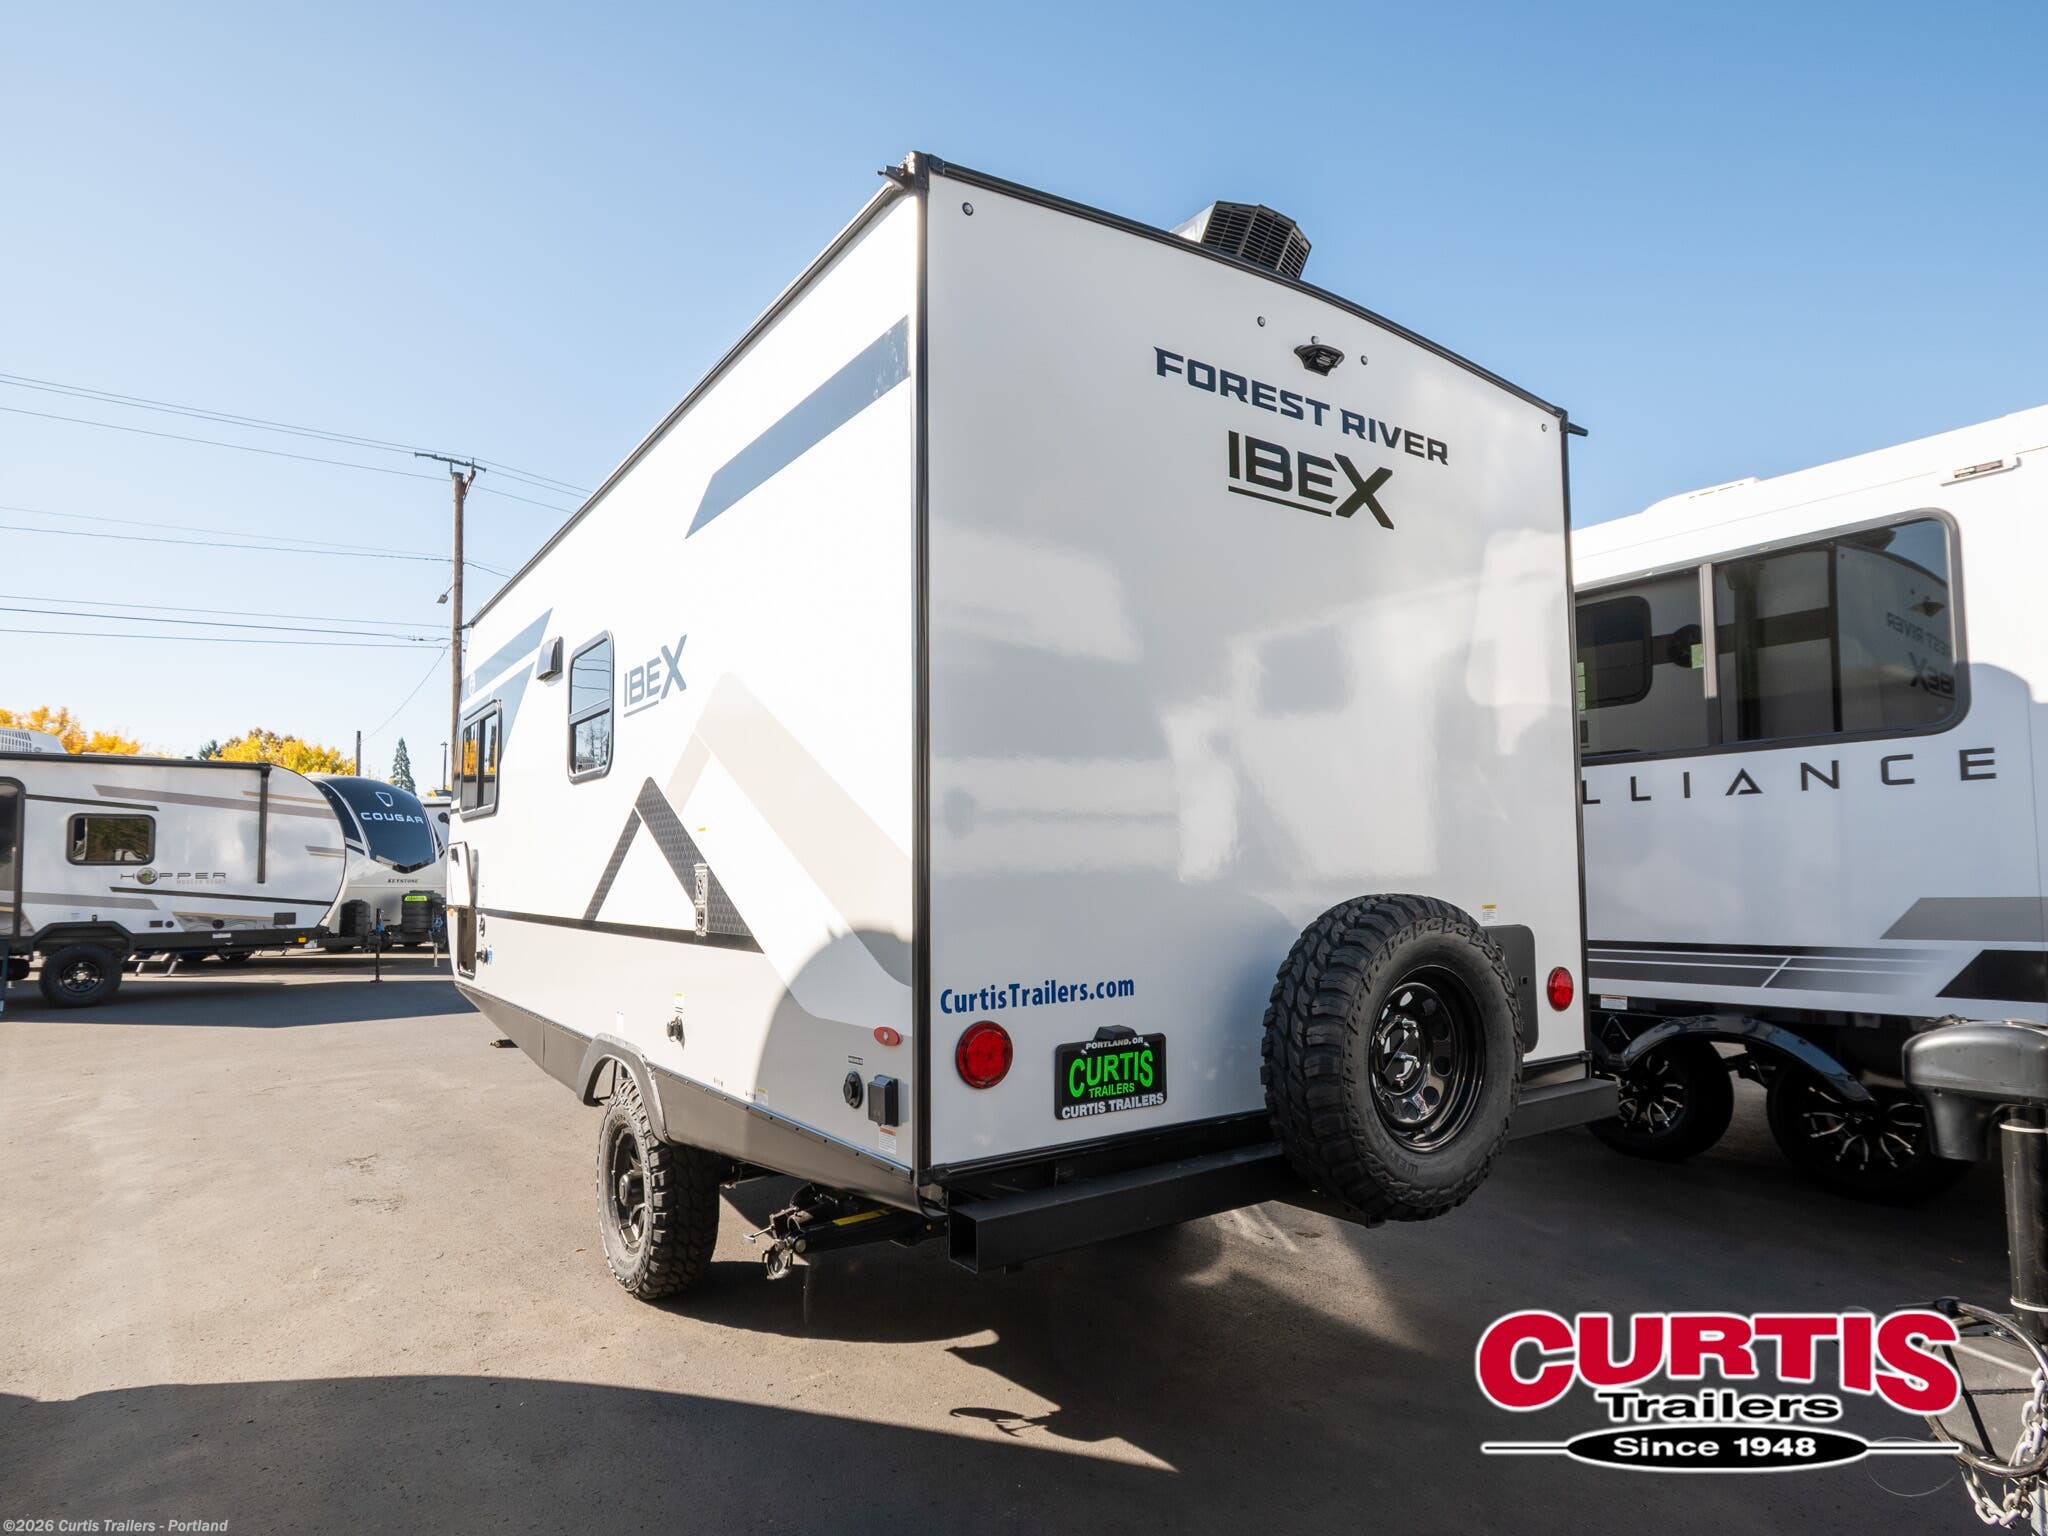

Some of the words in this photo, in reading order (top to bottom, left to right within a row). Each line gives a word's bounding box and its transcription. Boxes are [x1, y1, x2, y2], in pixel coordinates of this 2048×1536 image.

[1153, 346, 1330, 427] FOREST
[1339, 407, 1449, 466] RIVER
[1228, 430, 1394, 530] IBEX
[623, 633, 688, 708] IBEX
[1582, 747, 1997, 805] LLIANCE
[360, 812, 424, 824] COUGAR
[940, 978, 1135, 1015] CurtisTrailers.com
[1069, 1049, 1154, 1098] CURTIS
[1088, 1082, 1135, 1098] TRAILERS
[1062, 1101, 1106, 1119] CURTIS
[1109, 1092, 1164, 1112] TRAILERS
